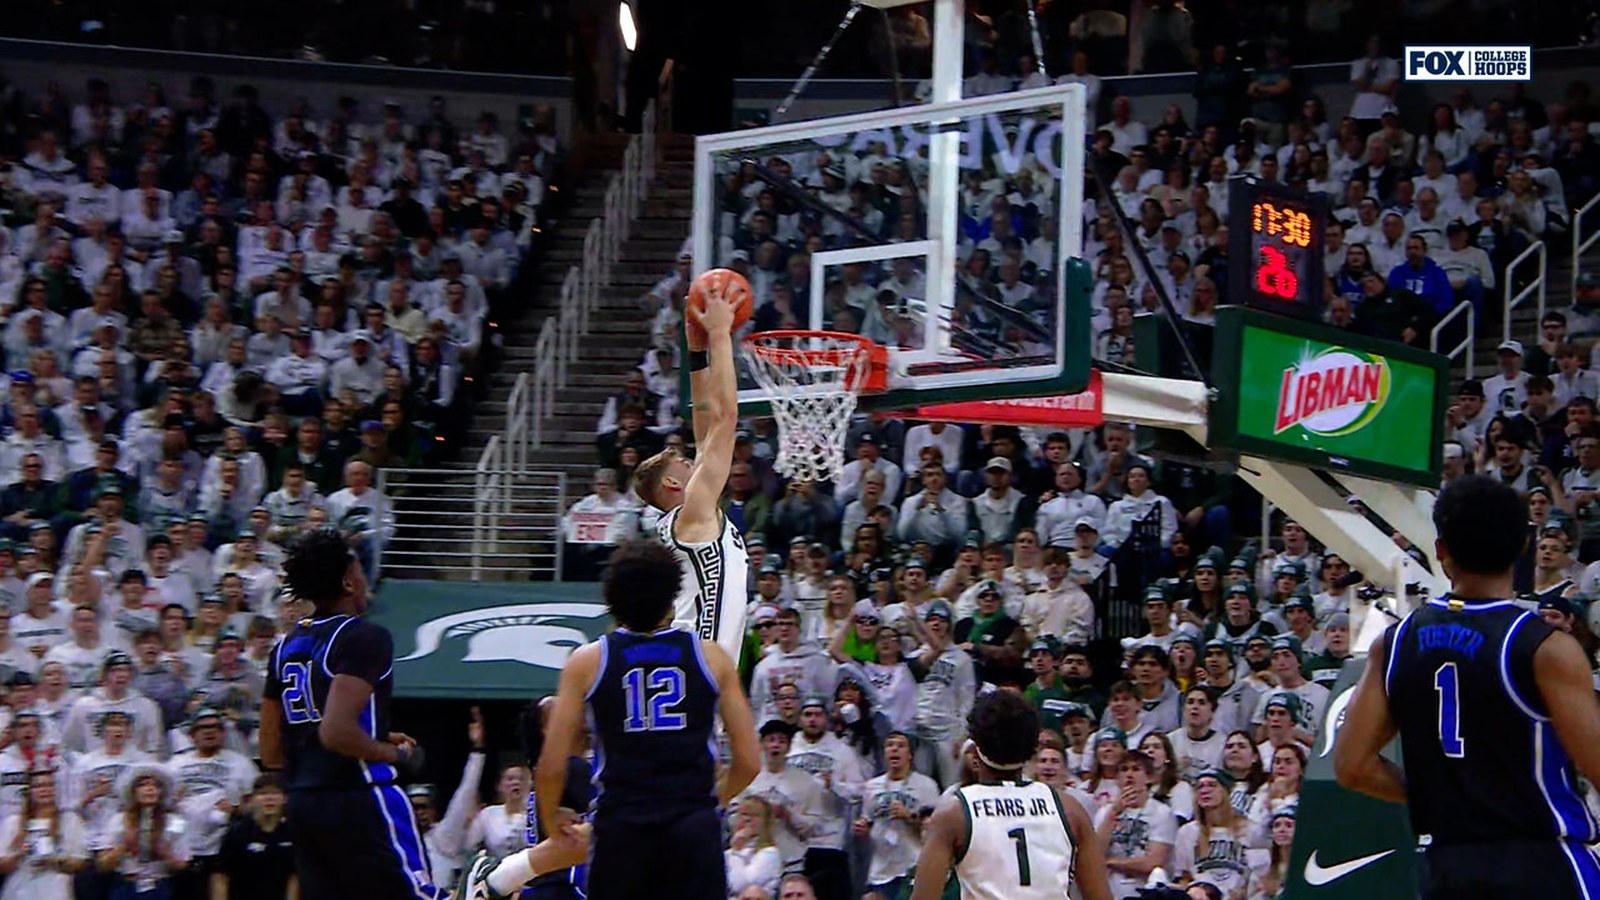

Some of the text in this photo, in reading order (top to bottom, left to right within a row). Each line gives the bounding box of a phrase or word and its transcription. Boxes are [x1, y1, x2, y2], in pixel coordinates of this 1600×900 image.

[1253, 202, 1311, 247] 17:30
[1273, 362, 1384, 434] LIBMAN
[1418, 623, 1485, 657] FOSTER
[281, 660, 322, 724] 21
[622, 666, 687, 732] 12
[1434, 661, 1465, 758] 1
[971, 797, 1056, 818] FEARS JR.
[1007, 827, 1031, 887] 1
